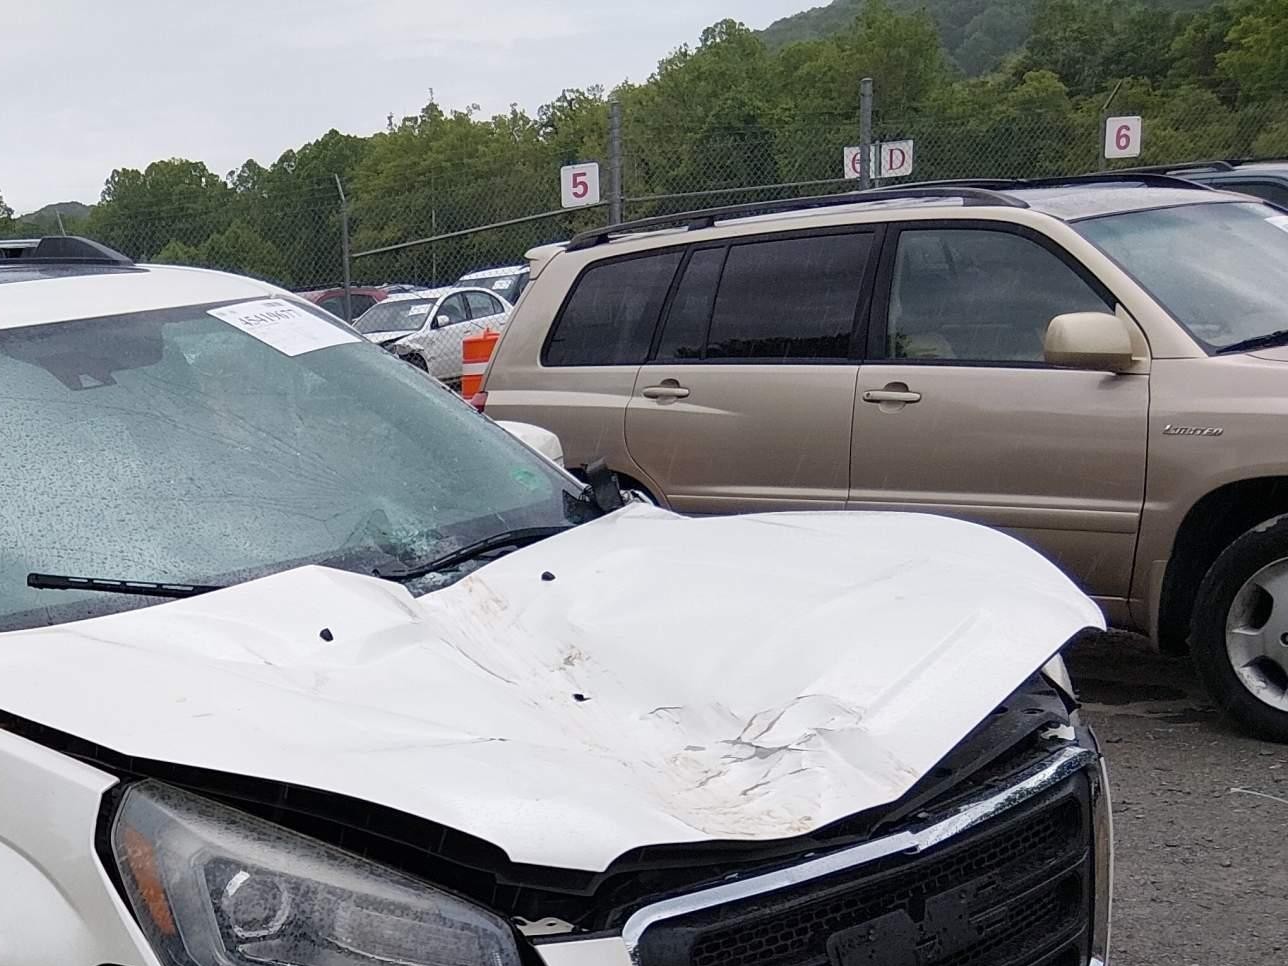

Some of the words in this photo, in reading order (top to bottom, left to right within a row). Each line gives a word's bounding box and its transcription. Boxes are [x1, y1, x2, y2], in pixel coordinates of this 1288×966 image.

[1115, 124, 1131, 151] 6
[887, 147, 906, 171] D
[572, 172, 589, 199] 5
